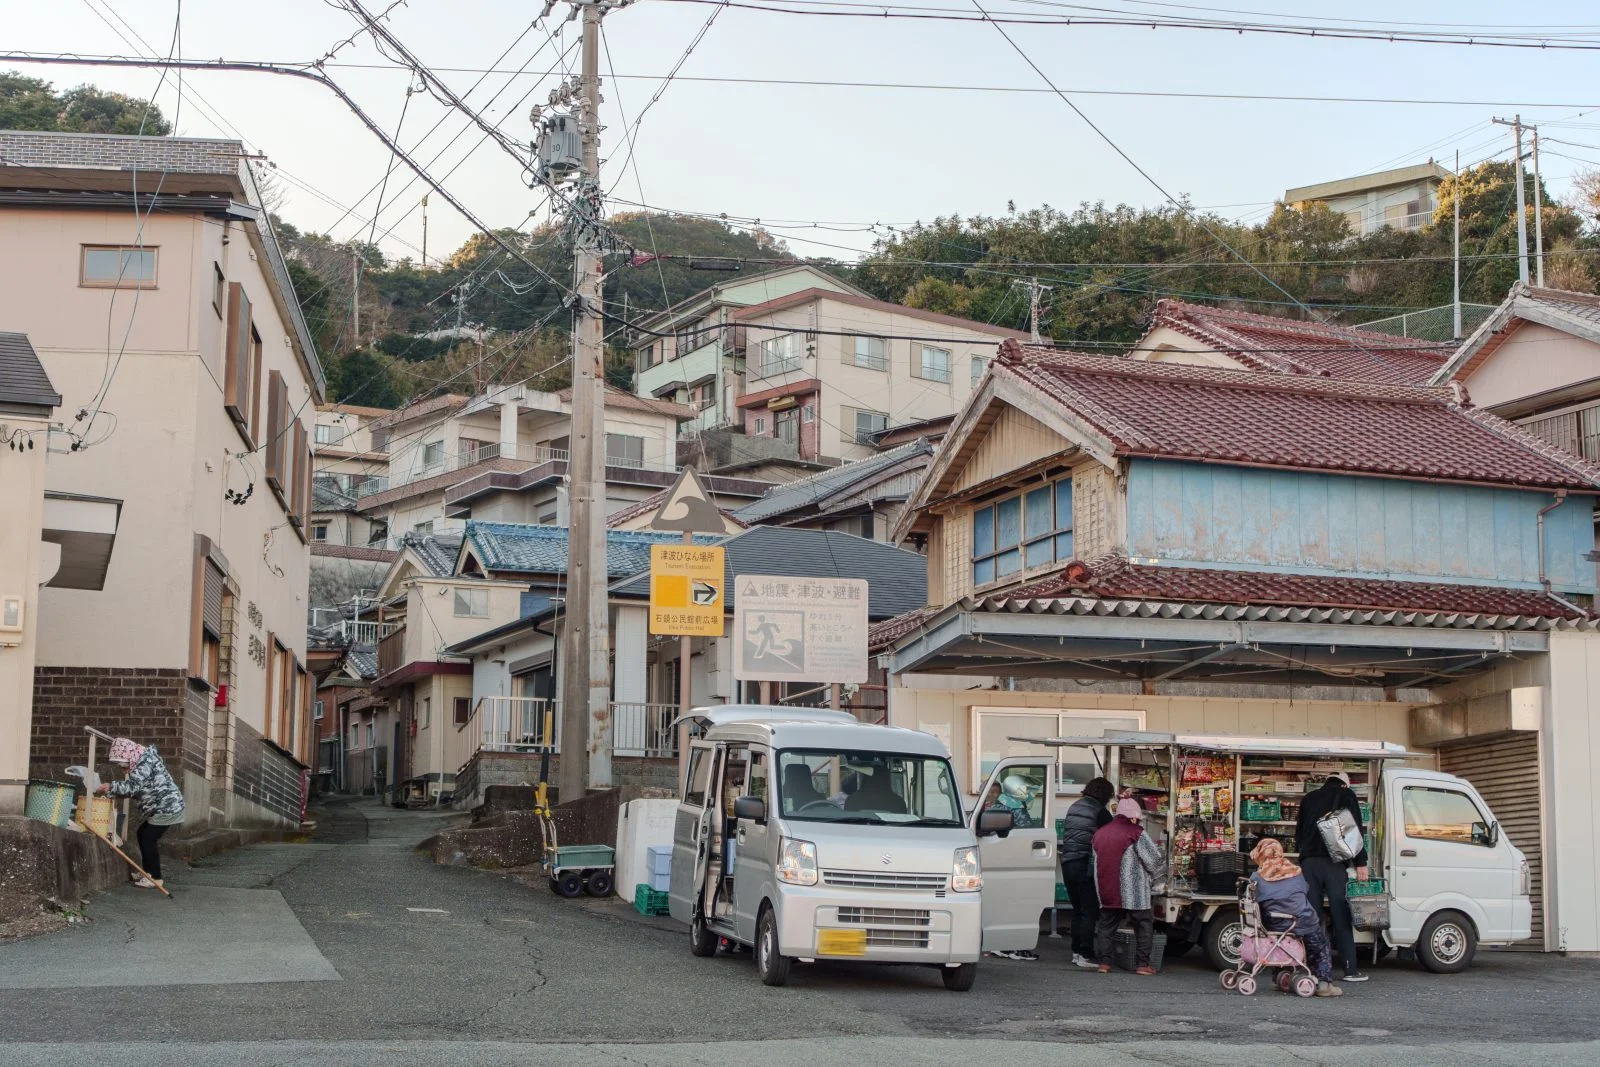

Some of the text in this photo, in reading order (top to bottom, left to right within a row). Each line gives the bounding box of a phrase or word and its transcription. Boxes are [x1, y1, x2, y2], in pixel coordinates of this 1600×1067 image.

[660, 551, 715, 562] 津波ひなん場所
[655, 614, 719, 625] 石鏡公民館前広場
